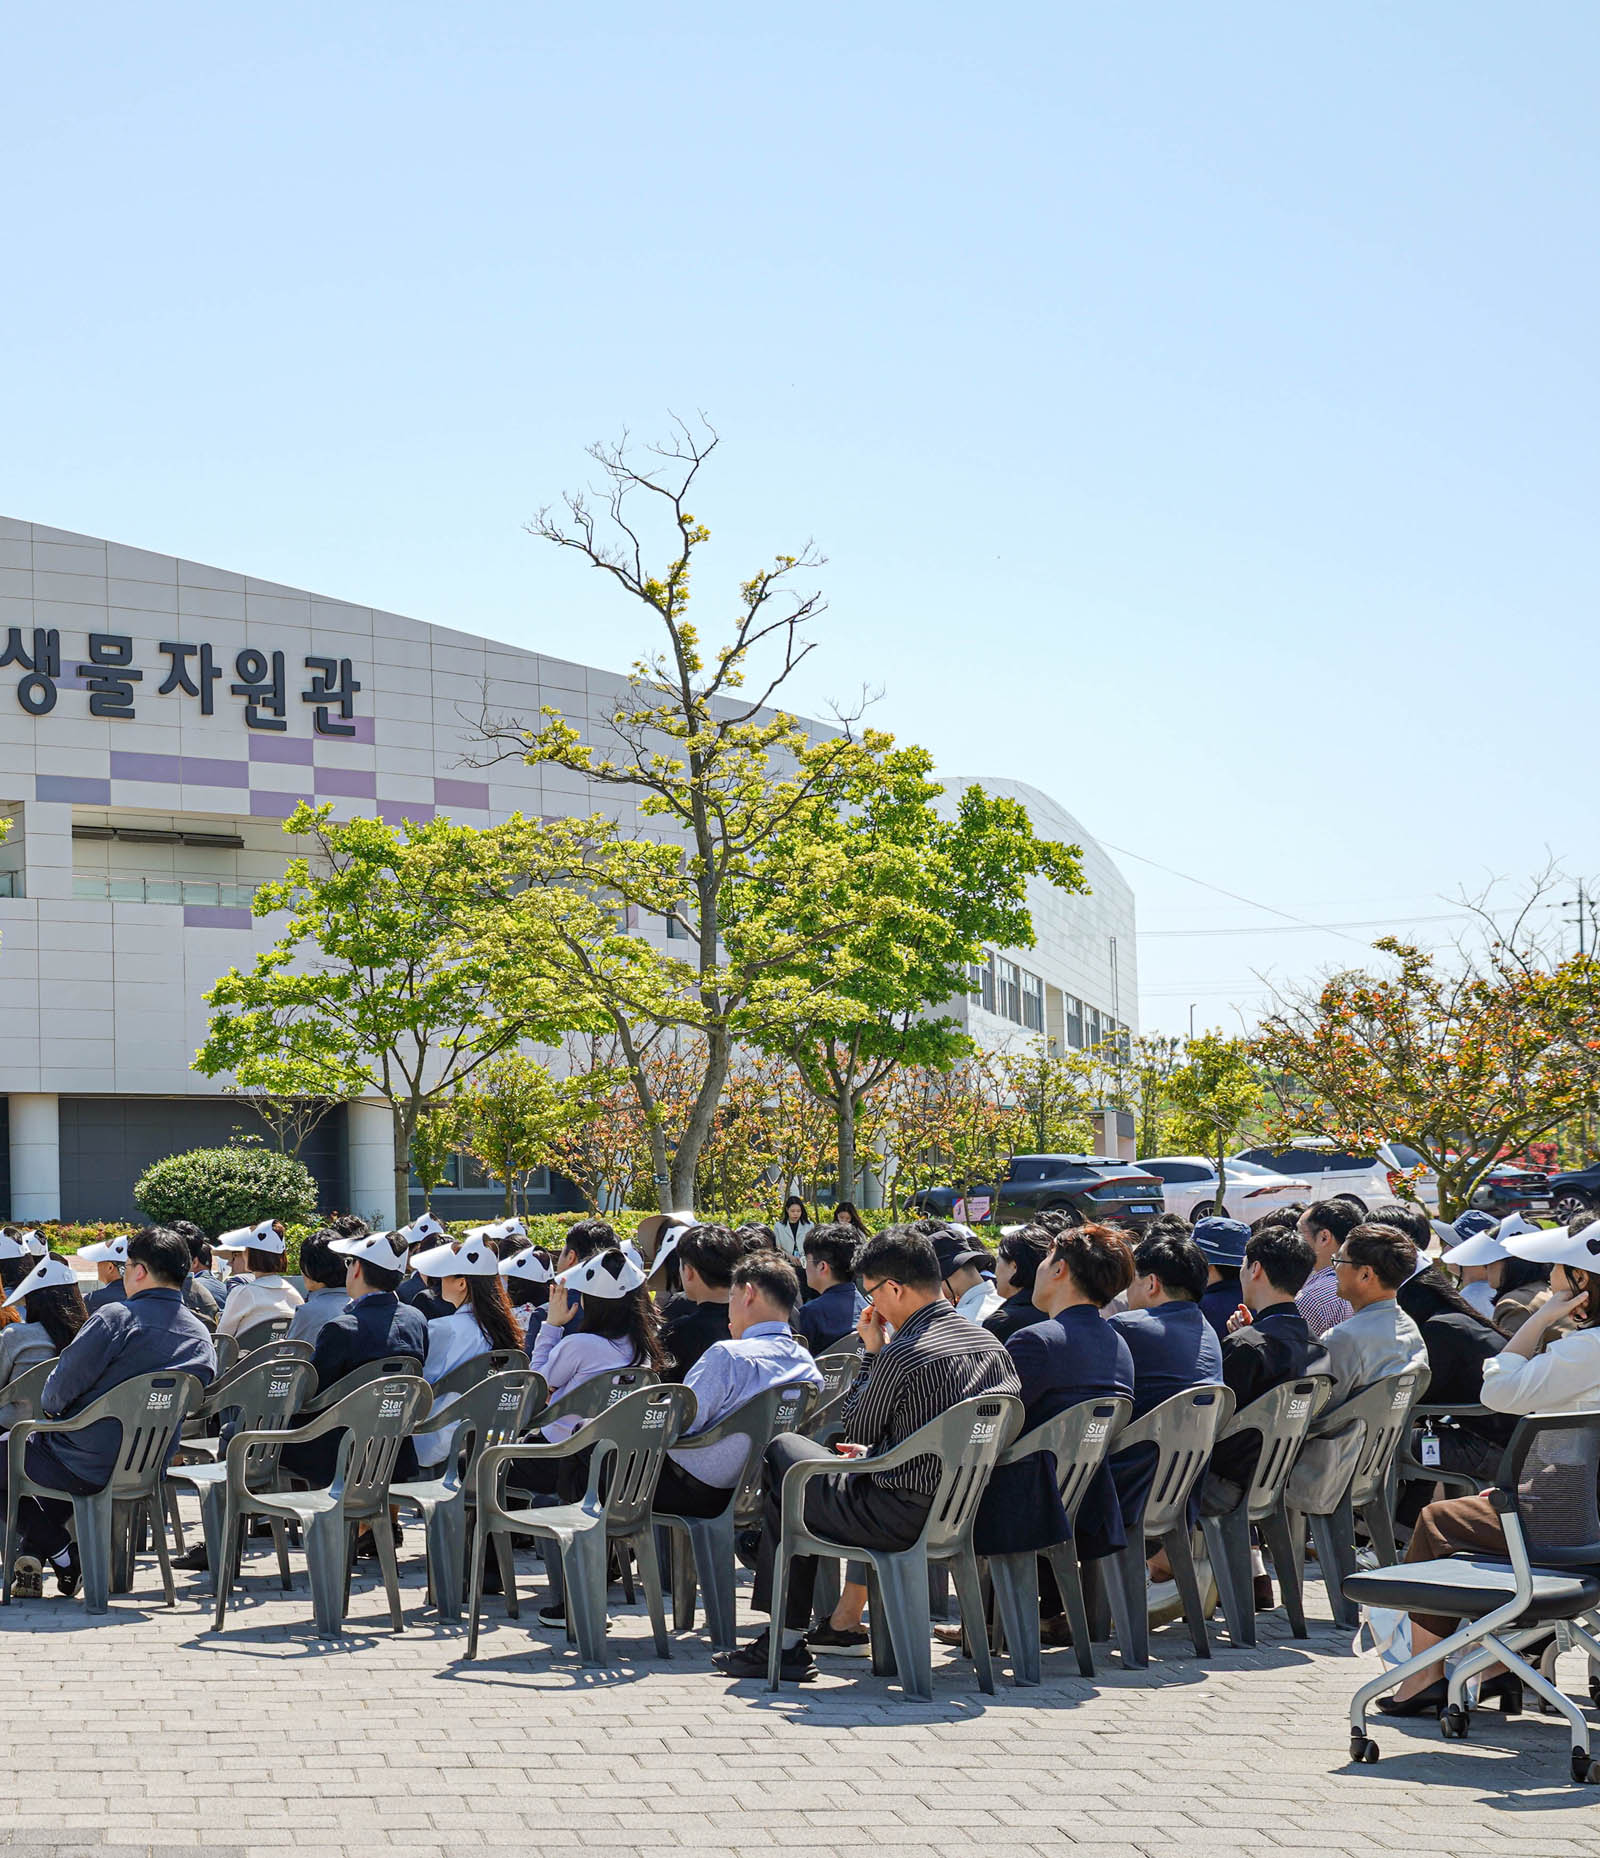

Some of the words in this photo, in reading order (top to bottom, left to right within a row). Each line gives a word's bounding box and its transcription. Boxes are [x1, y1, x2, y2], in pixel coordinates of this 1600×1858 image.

[824, 1374, 841, 1382] Star
[270, 1381, 290, 1390] Star
[149, 1393, 173, 1402] Star
[500, 1393, 521, 1403] Star
[381, 1399, 403, 1409] Star
[1290, 1399, 1310, 1410] Star
[644, 1410, 667, 1420] Star
[778, 1406, 797, 1416] Star
[973, 1423, 996, 1434] Star
[1087, 1423, 1108, 1434] Star
